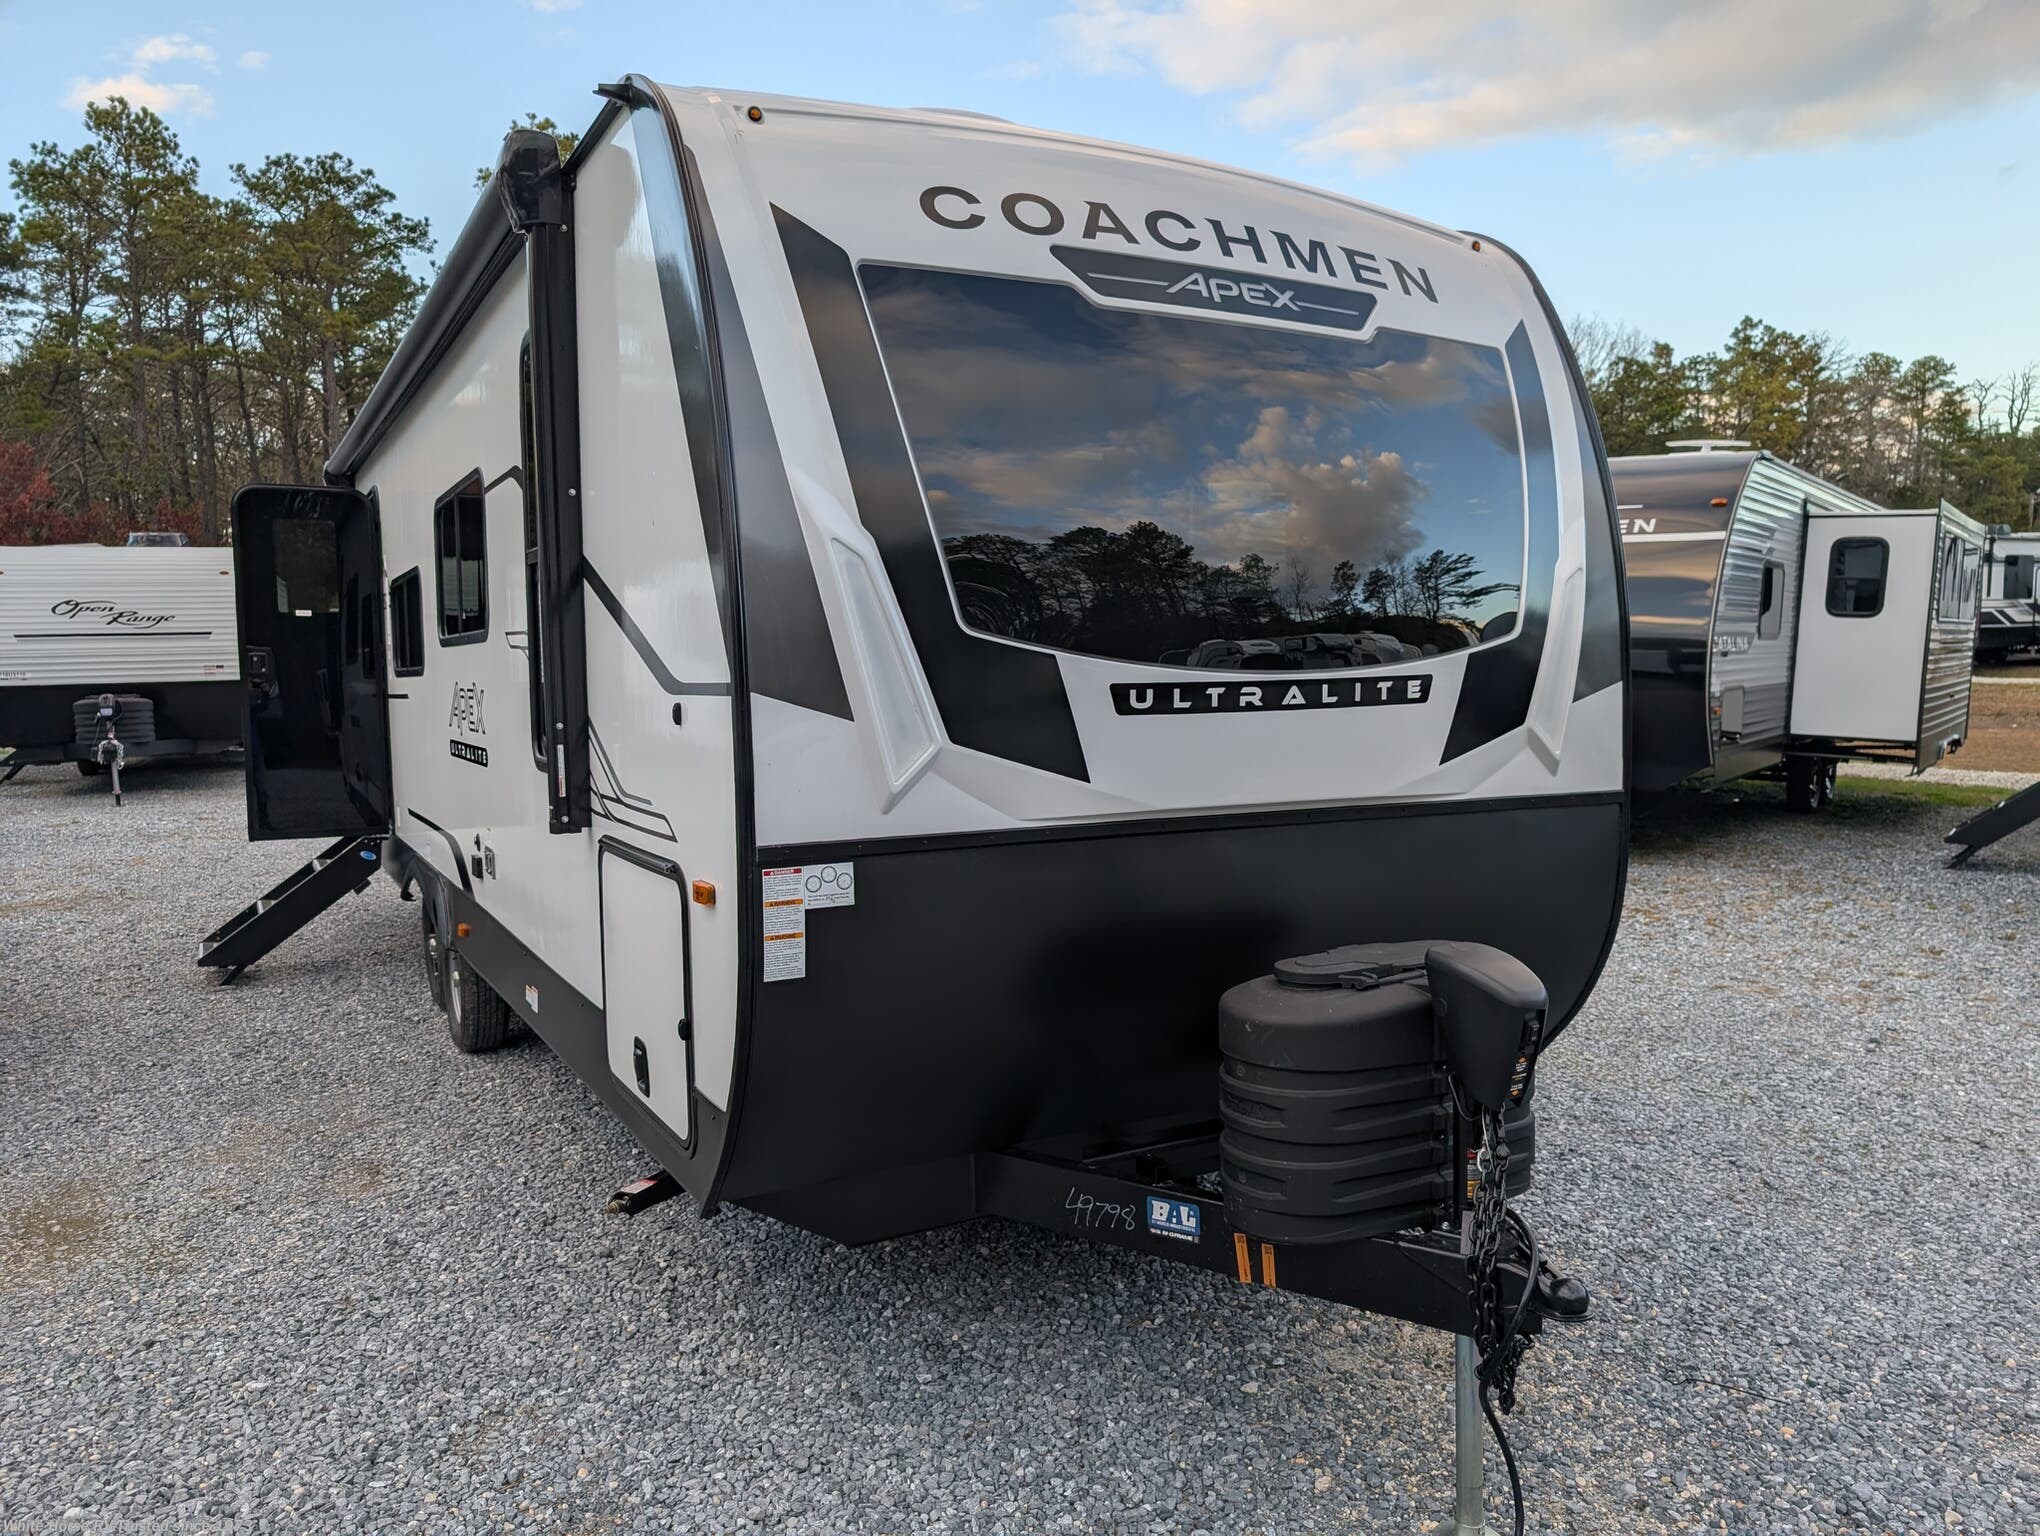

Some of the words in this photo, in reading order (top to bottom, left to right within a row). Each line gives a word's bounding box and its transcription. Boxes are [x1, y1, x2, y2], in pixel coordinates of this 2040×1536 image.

[919, 185, 1440, 304] COACHMEN
[1165, 272, 1302, 311] APEX
[51, 599, 118, 619] Open
[101, 611, 175, 629] Range
[448, 681, 486, 737] APEX
[1129, 679, 1423, 709] ULTRALITE
[450, 741, 487, 765] ULTRALITE
[1065, 1186, 1136, 1231] 49798
[1151, 1199, 1196, 1228] BAL
